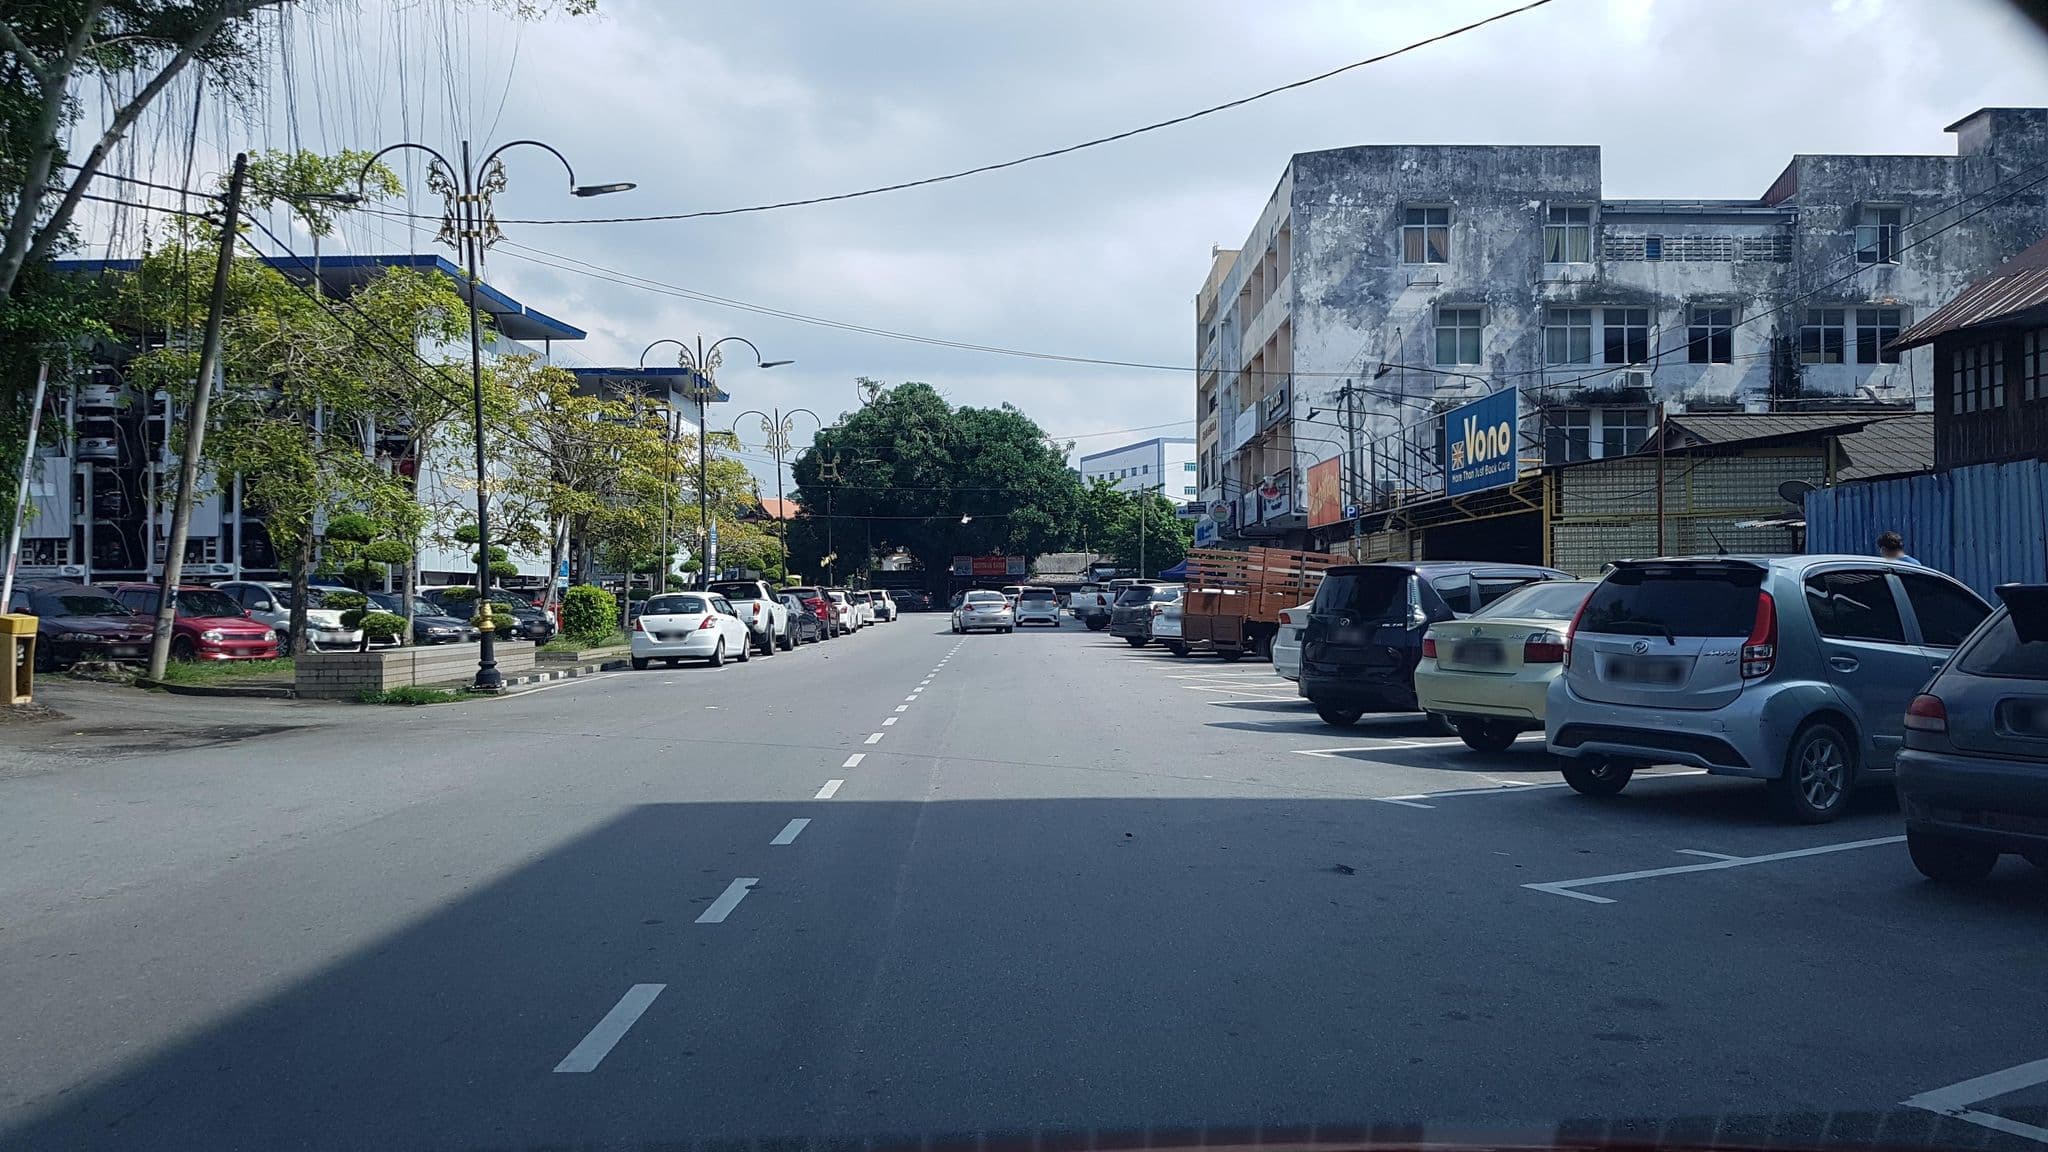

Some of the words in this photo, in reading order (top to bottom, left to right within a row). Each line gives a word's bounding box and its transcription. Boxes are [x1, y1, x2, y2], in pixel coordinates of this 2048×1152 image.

[1463, 414, 1510, 465] Vono
[1485, 464, 1497, 475] Back
[1498, 461, 1510, 471] Care
[1346, 506, 1356, 518] P
